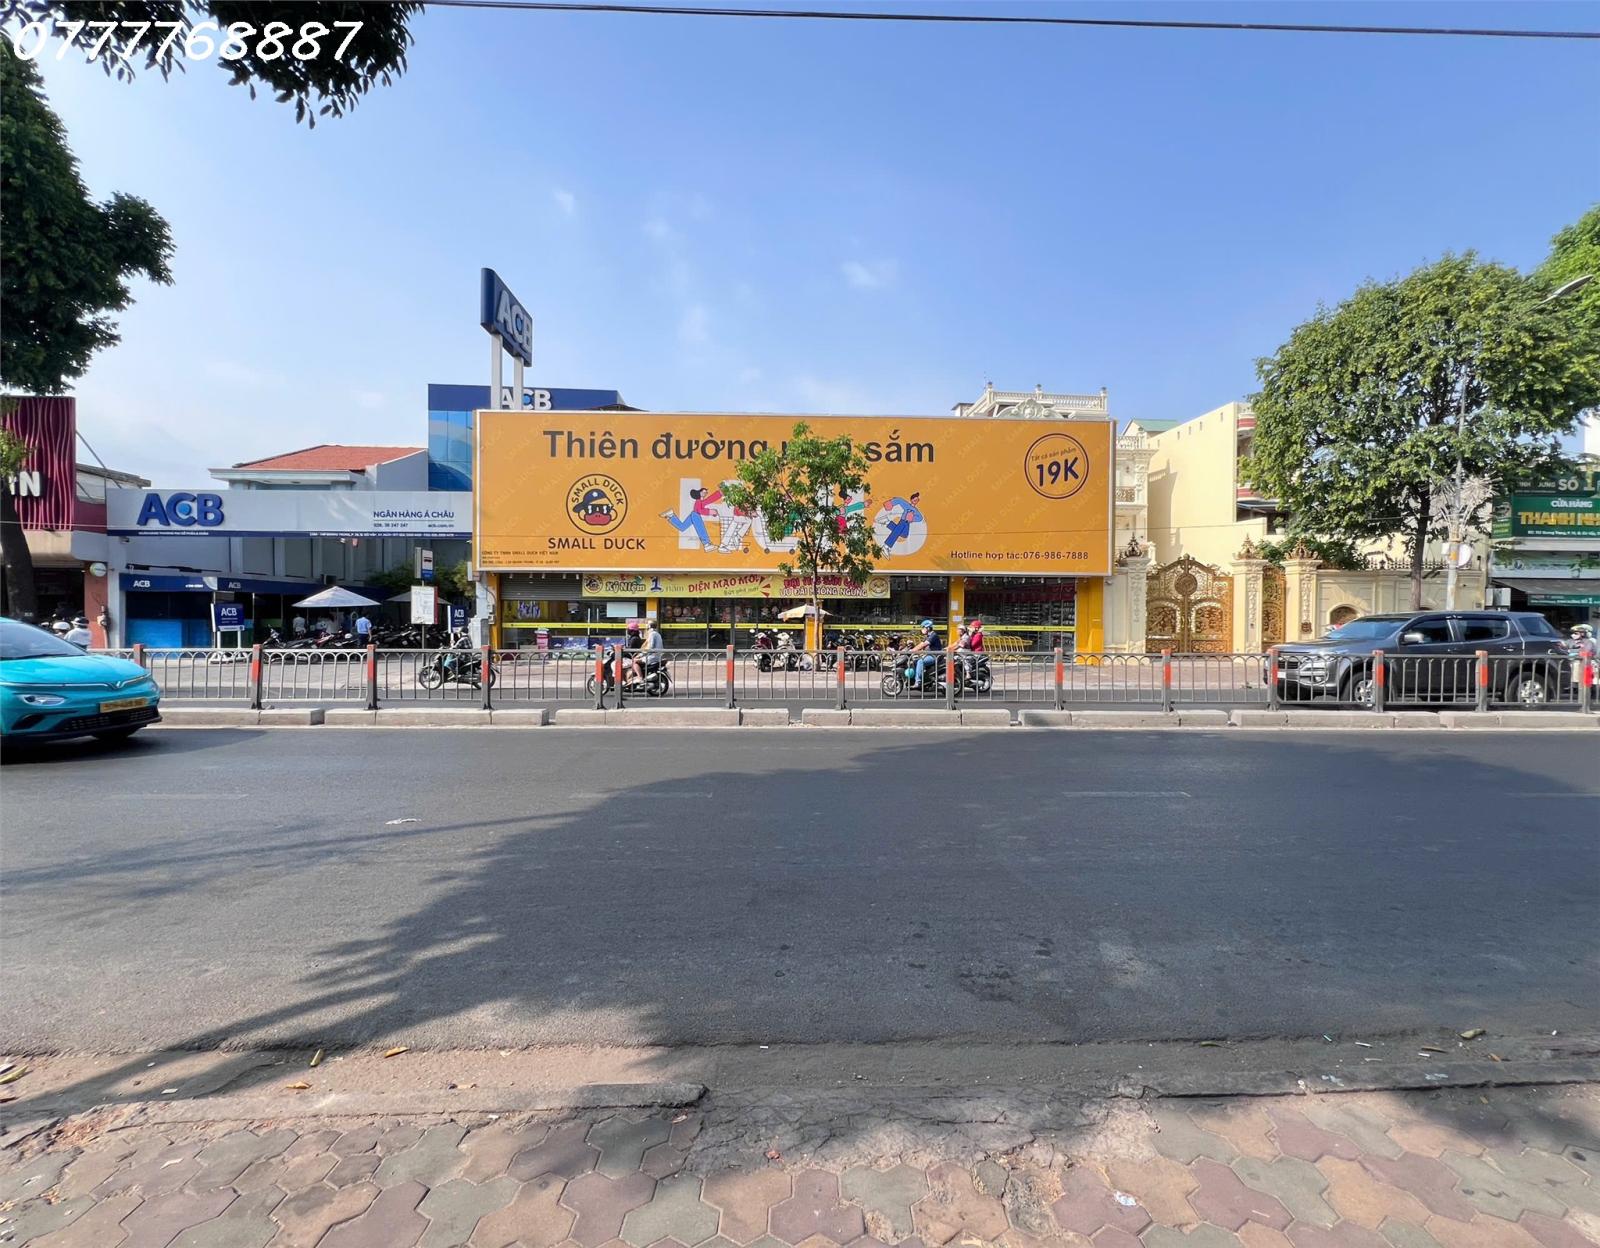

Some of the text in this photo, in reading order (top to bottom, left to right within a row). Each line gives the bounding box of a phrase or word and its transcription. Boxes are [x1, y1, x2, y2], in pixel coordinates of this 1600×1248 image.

[497, 289, 532, 348] ACB
[543, 430, 639, 459] Thiên
[865, 429, 934, 463] sắm
[1036, 457, 1079, 487] 19K
[1558, 475, 1579, 491] SỐ
[571, 478, 624, 505] SMALL DUCK
[136, 492, 224, 526] ACB
[373, 510, 455, 518] NGÂN HÀNG Á CHÂU
[1518, 511, 1576, 525] THANH
[548, 537, 646, 551] SMALL DUCK
[951, 551, 983, 560] Hotline
[133, 580, 151, 588] ACB
[221, 608, 238, 616] ACB
[454, 609, 465, 618] ACB
